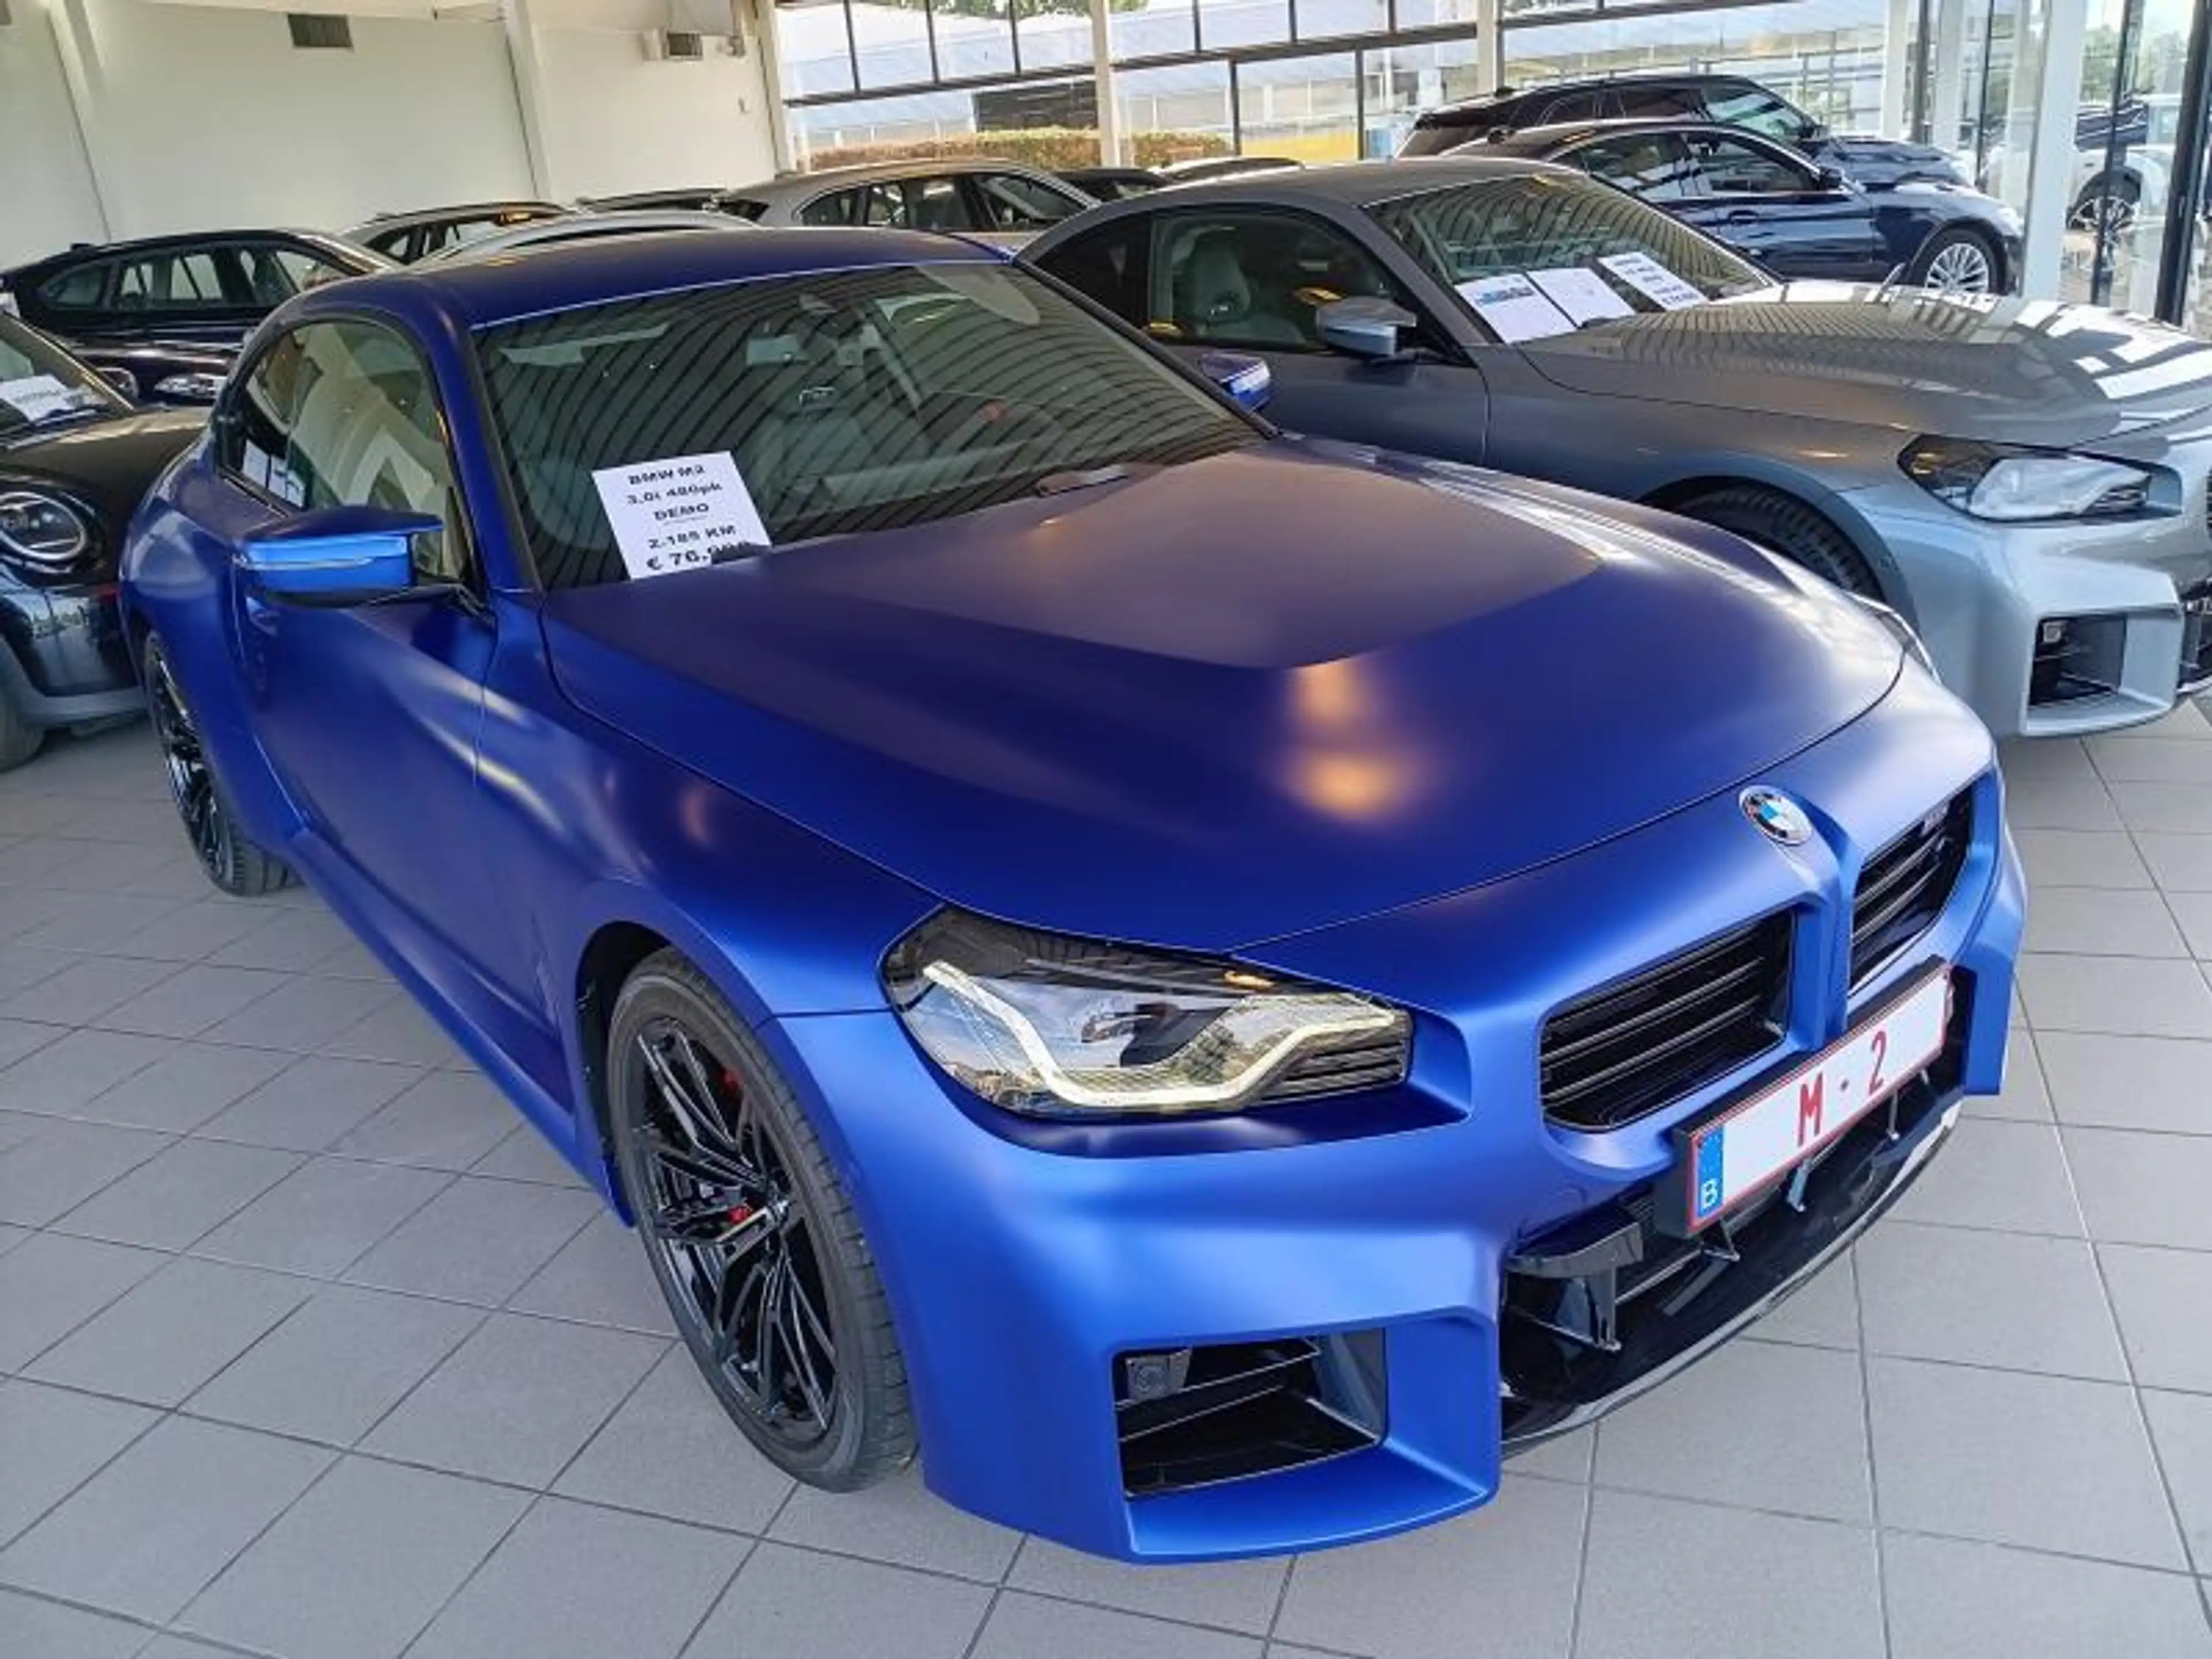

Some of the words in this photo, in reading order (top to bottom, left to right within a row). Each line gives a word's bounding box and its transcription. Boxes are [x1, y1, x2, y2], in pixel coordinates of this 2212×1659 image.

[628, 469, 674, 485] BMW
[677, 464, 706, 478] M2
[653, 502, 709, 520] DEMO
[706, 524, 737, 539] KM
[1701, 1178, 1719, 1210] B
